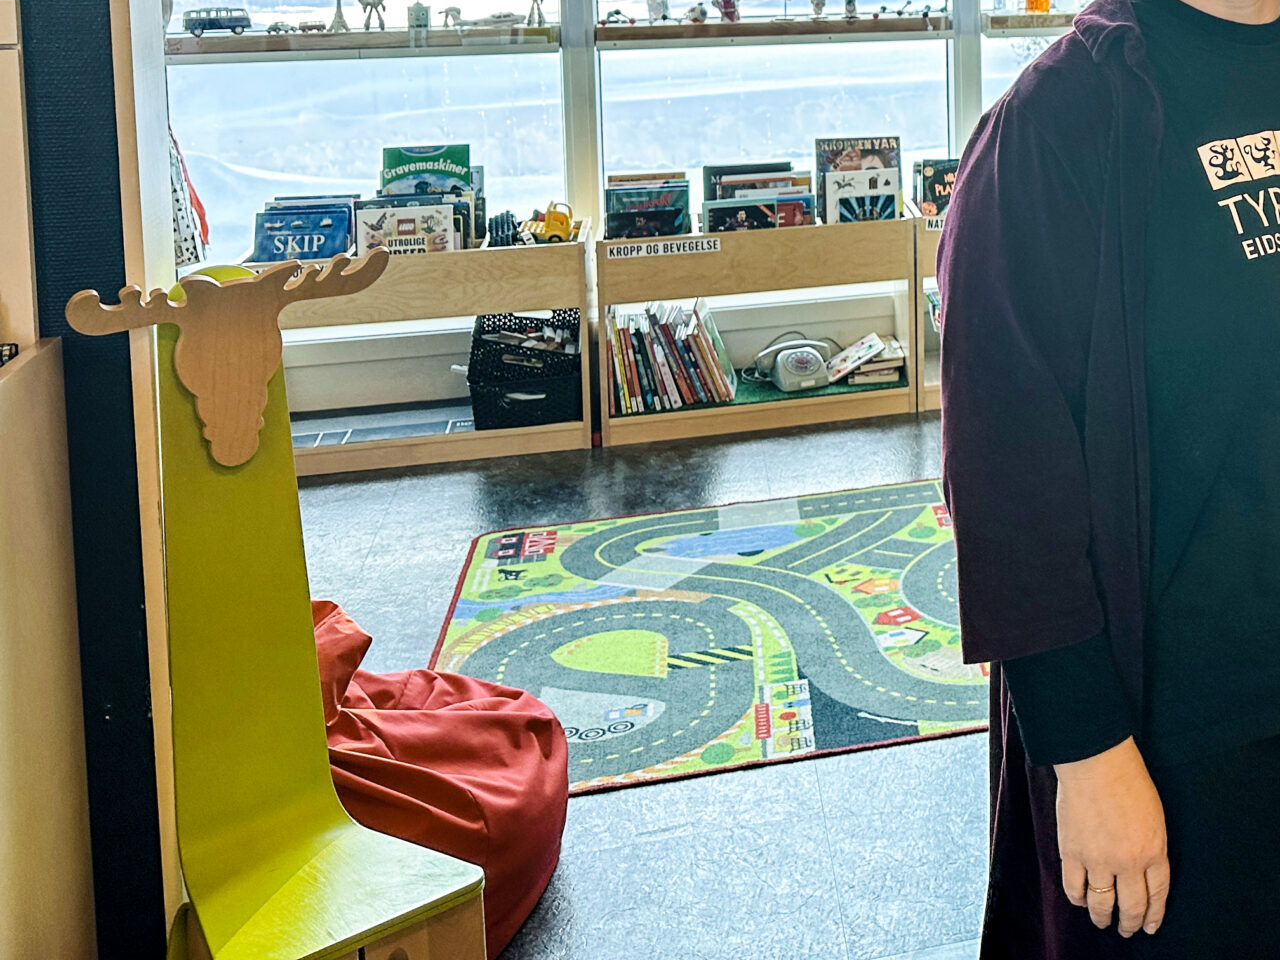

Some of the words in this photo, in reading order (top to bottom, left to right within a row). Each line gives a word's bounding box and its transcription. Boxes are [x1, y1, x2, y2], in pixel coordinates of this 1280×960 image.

[383, 158, 468, 180] Gravemaskiner
[273, 234, 326, 255] SKIP
[608, 244, 643, 258] KROPP
[646, 243, 660, 255] OG
[662, 239, 719, 254] BEVEGELSE
